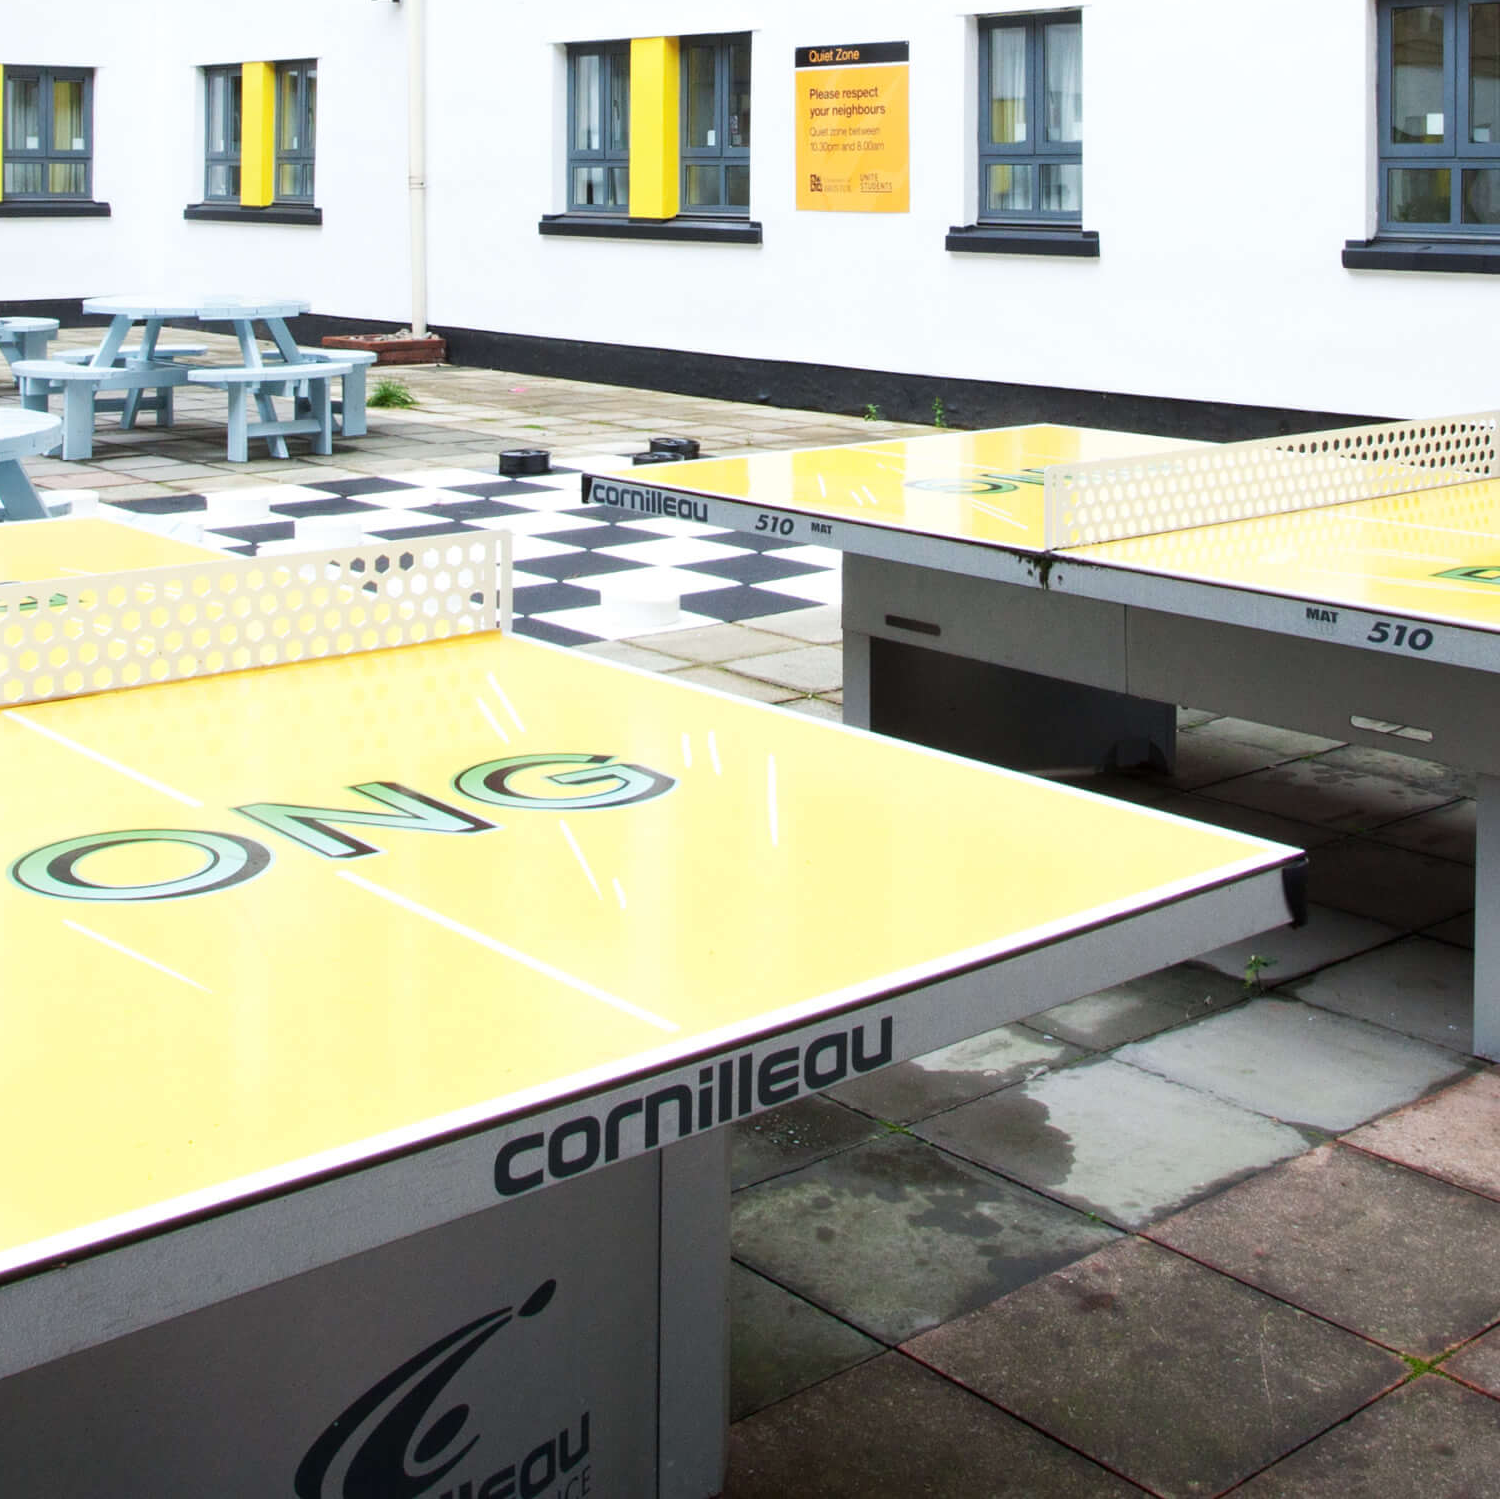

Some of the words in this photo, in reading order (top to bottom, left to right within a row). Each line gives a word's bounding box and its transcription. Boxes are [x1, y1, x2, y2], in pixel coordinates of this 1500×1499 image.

[809, 50, 833, 62] Quiet
[835, 48, 860, 61] Zone
[809, 88, 840, 100] Please
[842, 87, 878, 100] respect
[809, 107, 830, 119] your
[832, 104, 886, 118] neighbours
[810, 127, 829, 137] Quiet
[755, 513, 795, 536] 510
[810, 520, 833, 536] MAT
[1305, 606, 1340, 624] MAT
[1367, 621, 1434, 652] 510
